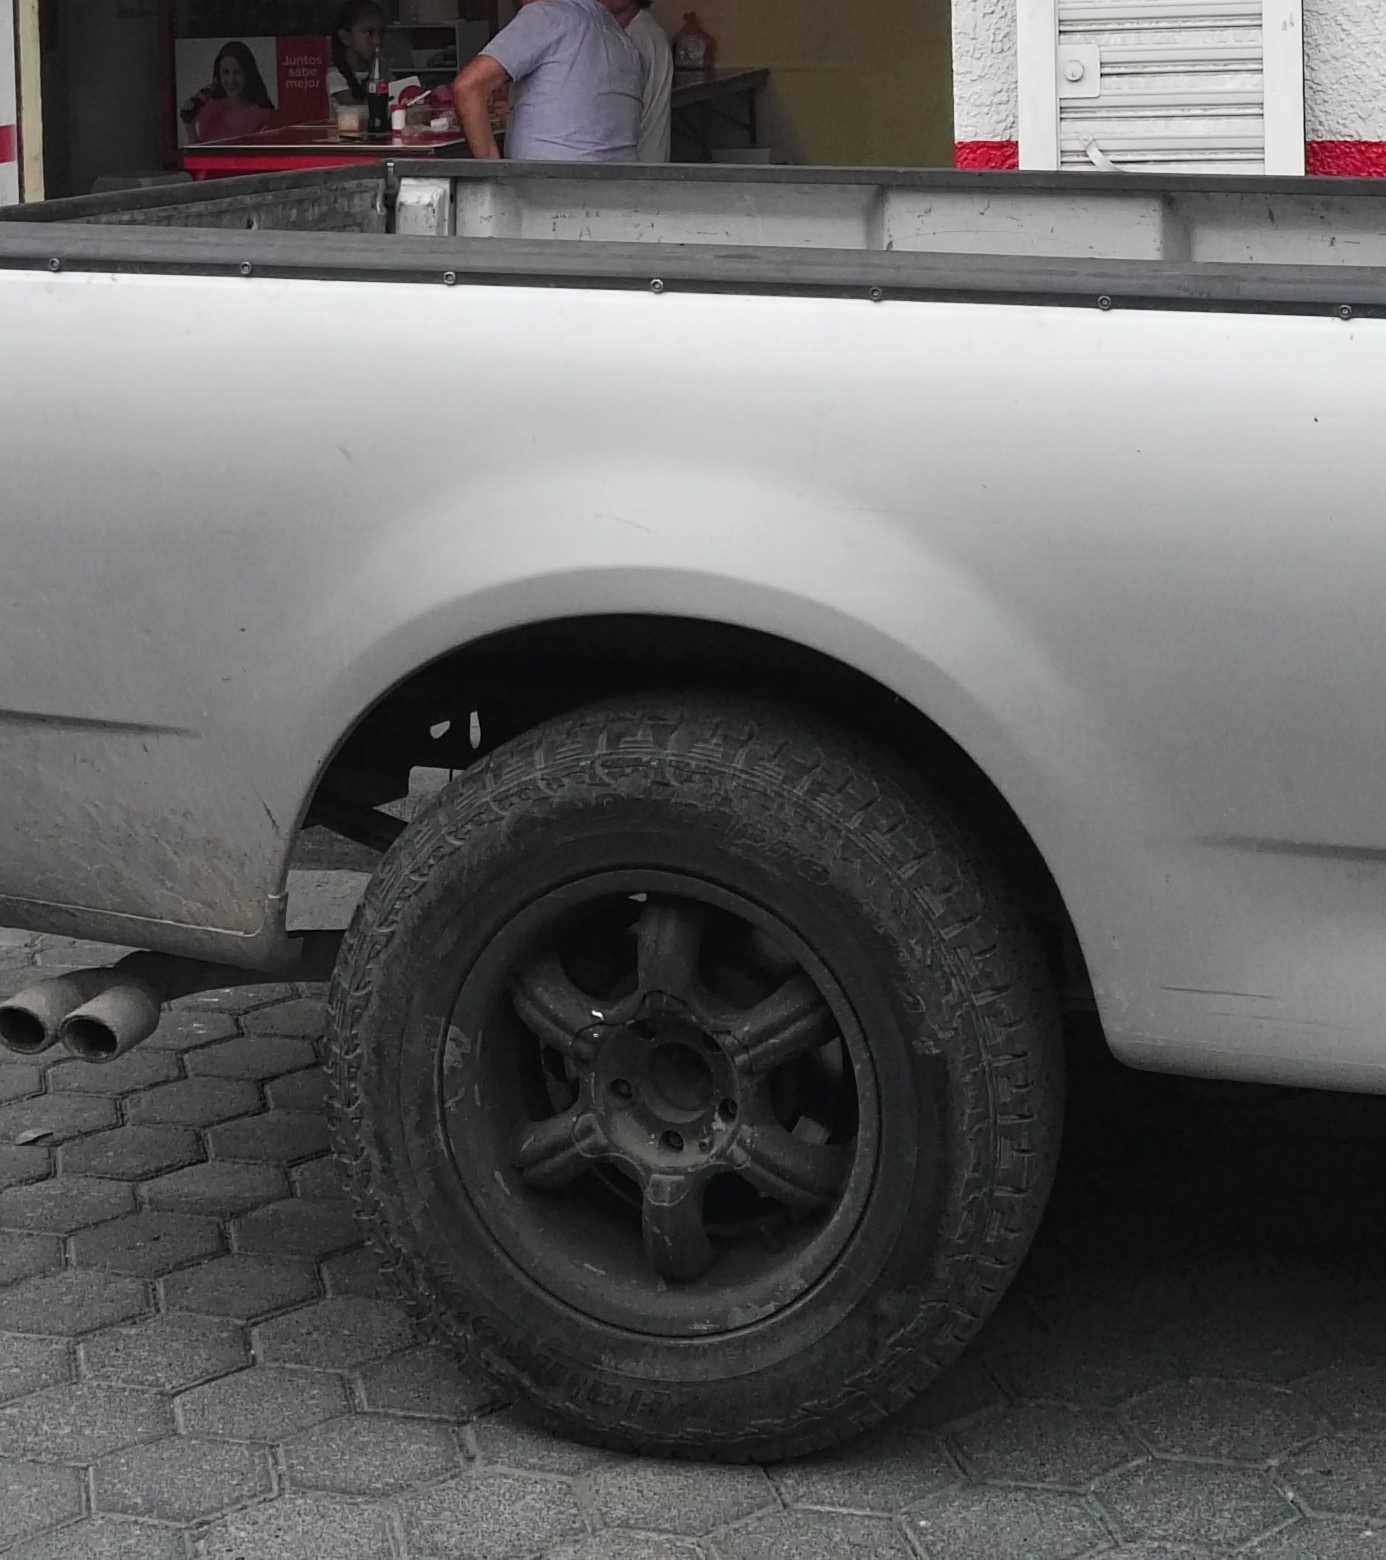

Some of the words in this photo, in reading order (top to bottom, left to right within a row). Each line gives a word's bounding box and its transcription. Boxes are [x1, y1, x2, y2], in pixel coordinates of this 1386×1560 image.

[281, 55, 323, 67] Juntos
[288, 67, 317, 78] sabe
[285, 78, 321, 91] mejor
